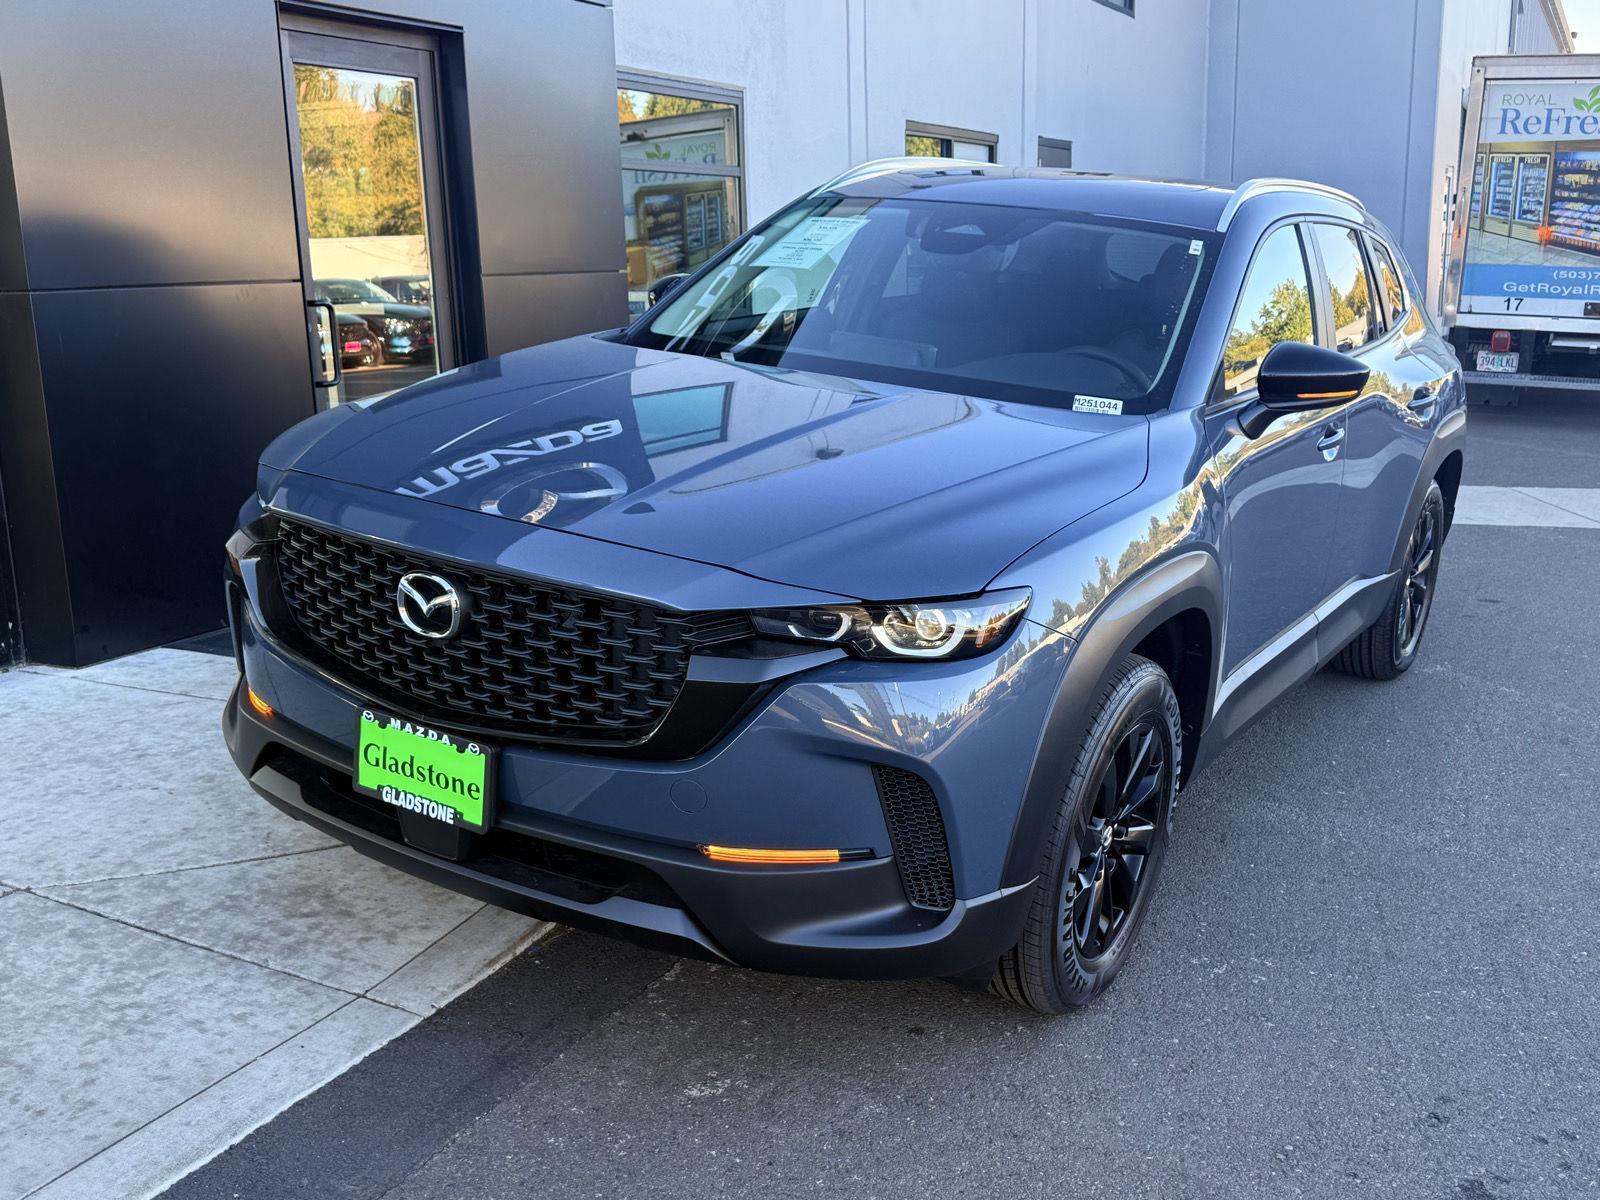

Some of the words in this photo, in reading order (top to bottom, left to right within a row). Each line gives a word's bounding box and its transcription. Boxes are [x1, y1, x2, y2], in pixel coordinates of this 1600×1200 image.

[1502, 94, 1557, 106] ROYAL
[1503, 297, 1524, 311] 17
[1073, 398, 1118, 410] M251044
[390, 717, 452, 746] MAZDA
[363, 742, 481, 801] Gladstone
[382, 785, 455, 825] GLADSTONE
